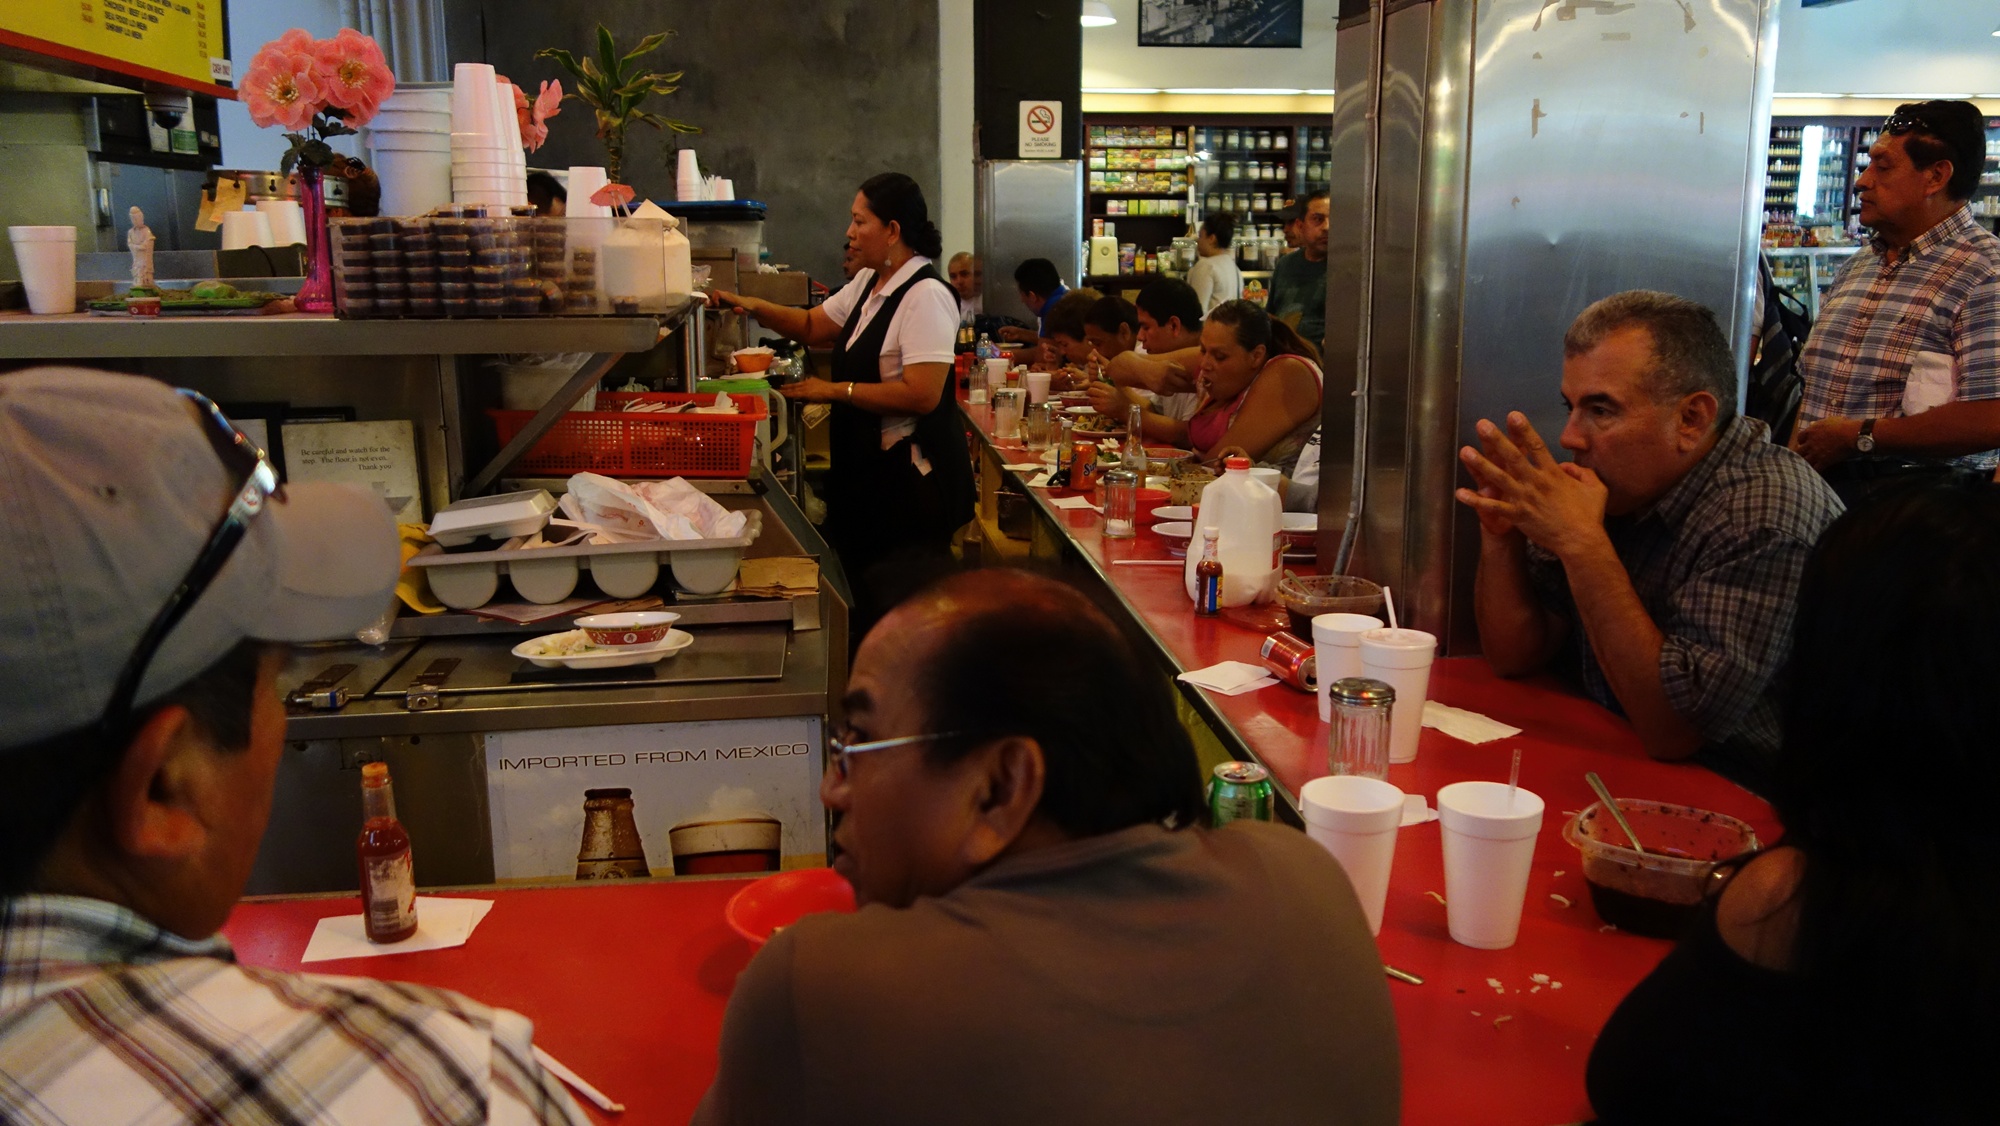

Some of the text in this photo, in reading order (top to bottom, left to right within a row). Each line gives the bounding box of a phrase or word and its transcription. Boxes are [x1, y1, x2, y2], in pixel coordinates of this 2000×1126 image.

[499, 743, 809, 770] IMPORTED FROM MEXICO
